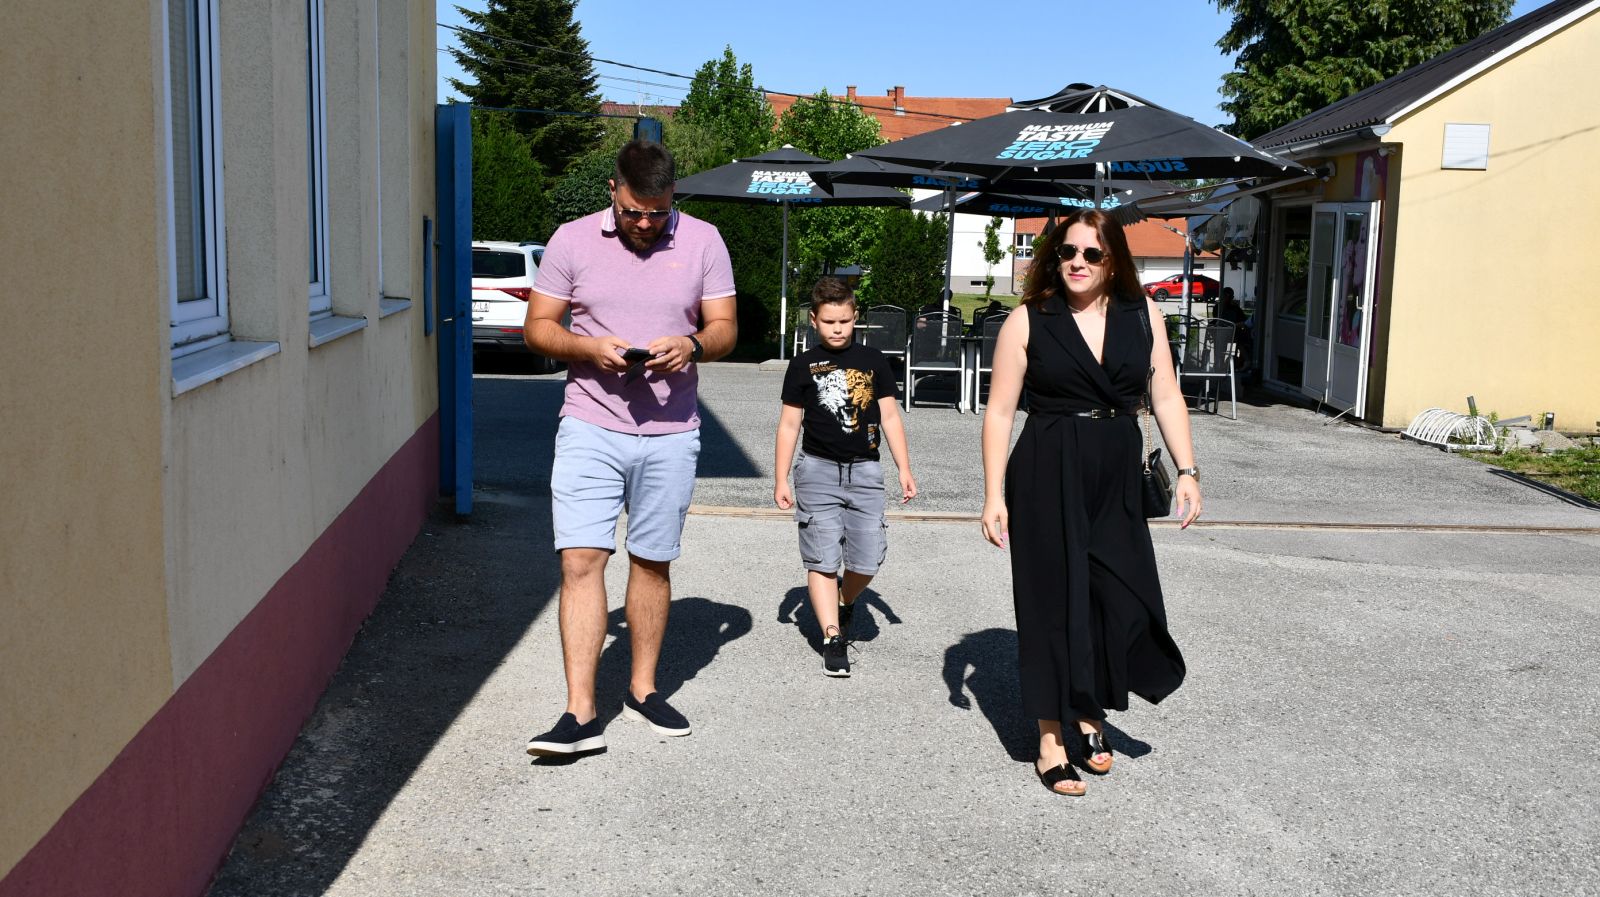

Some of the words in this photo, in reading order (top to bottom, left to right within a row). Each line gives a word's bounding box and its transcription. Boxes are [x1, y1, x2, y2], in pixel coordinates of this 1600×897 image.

[1023, 121, 1115, 132] MAXIMUM
[1016, 128, 1111, 142] TASTE
[1005, 139, 1101, 151] ZERO
[995, 149, 1094, 160] SUGAR
[752, 175, 812, 183] TASTE
[746, 187, 812, 195] SUGAR
